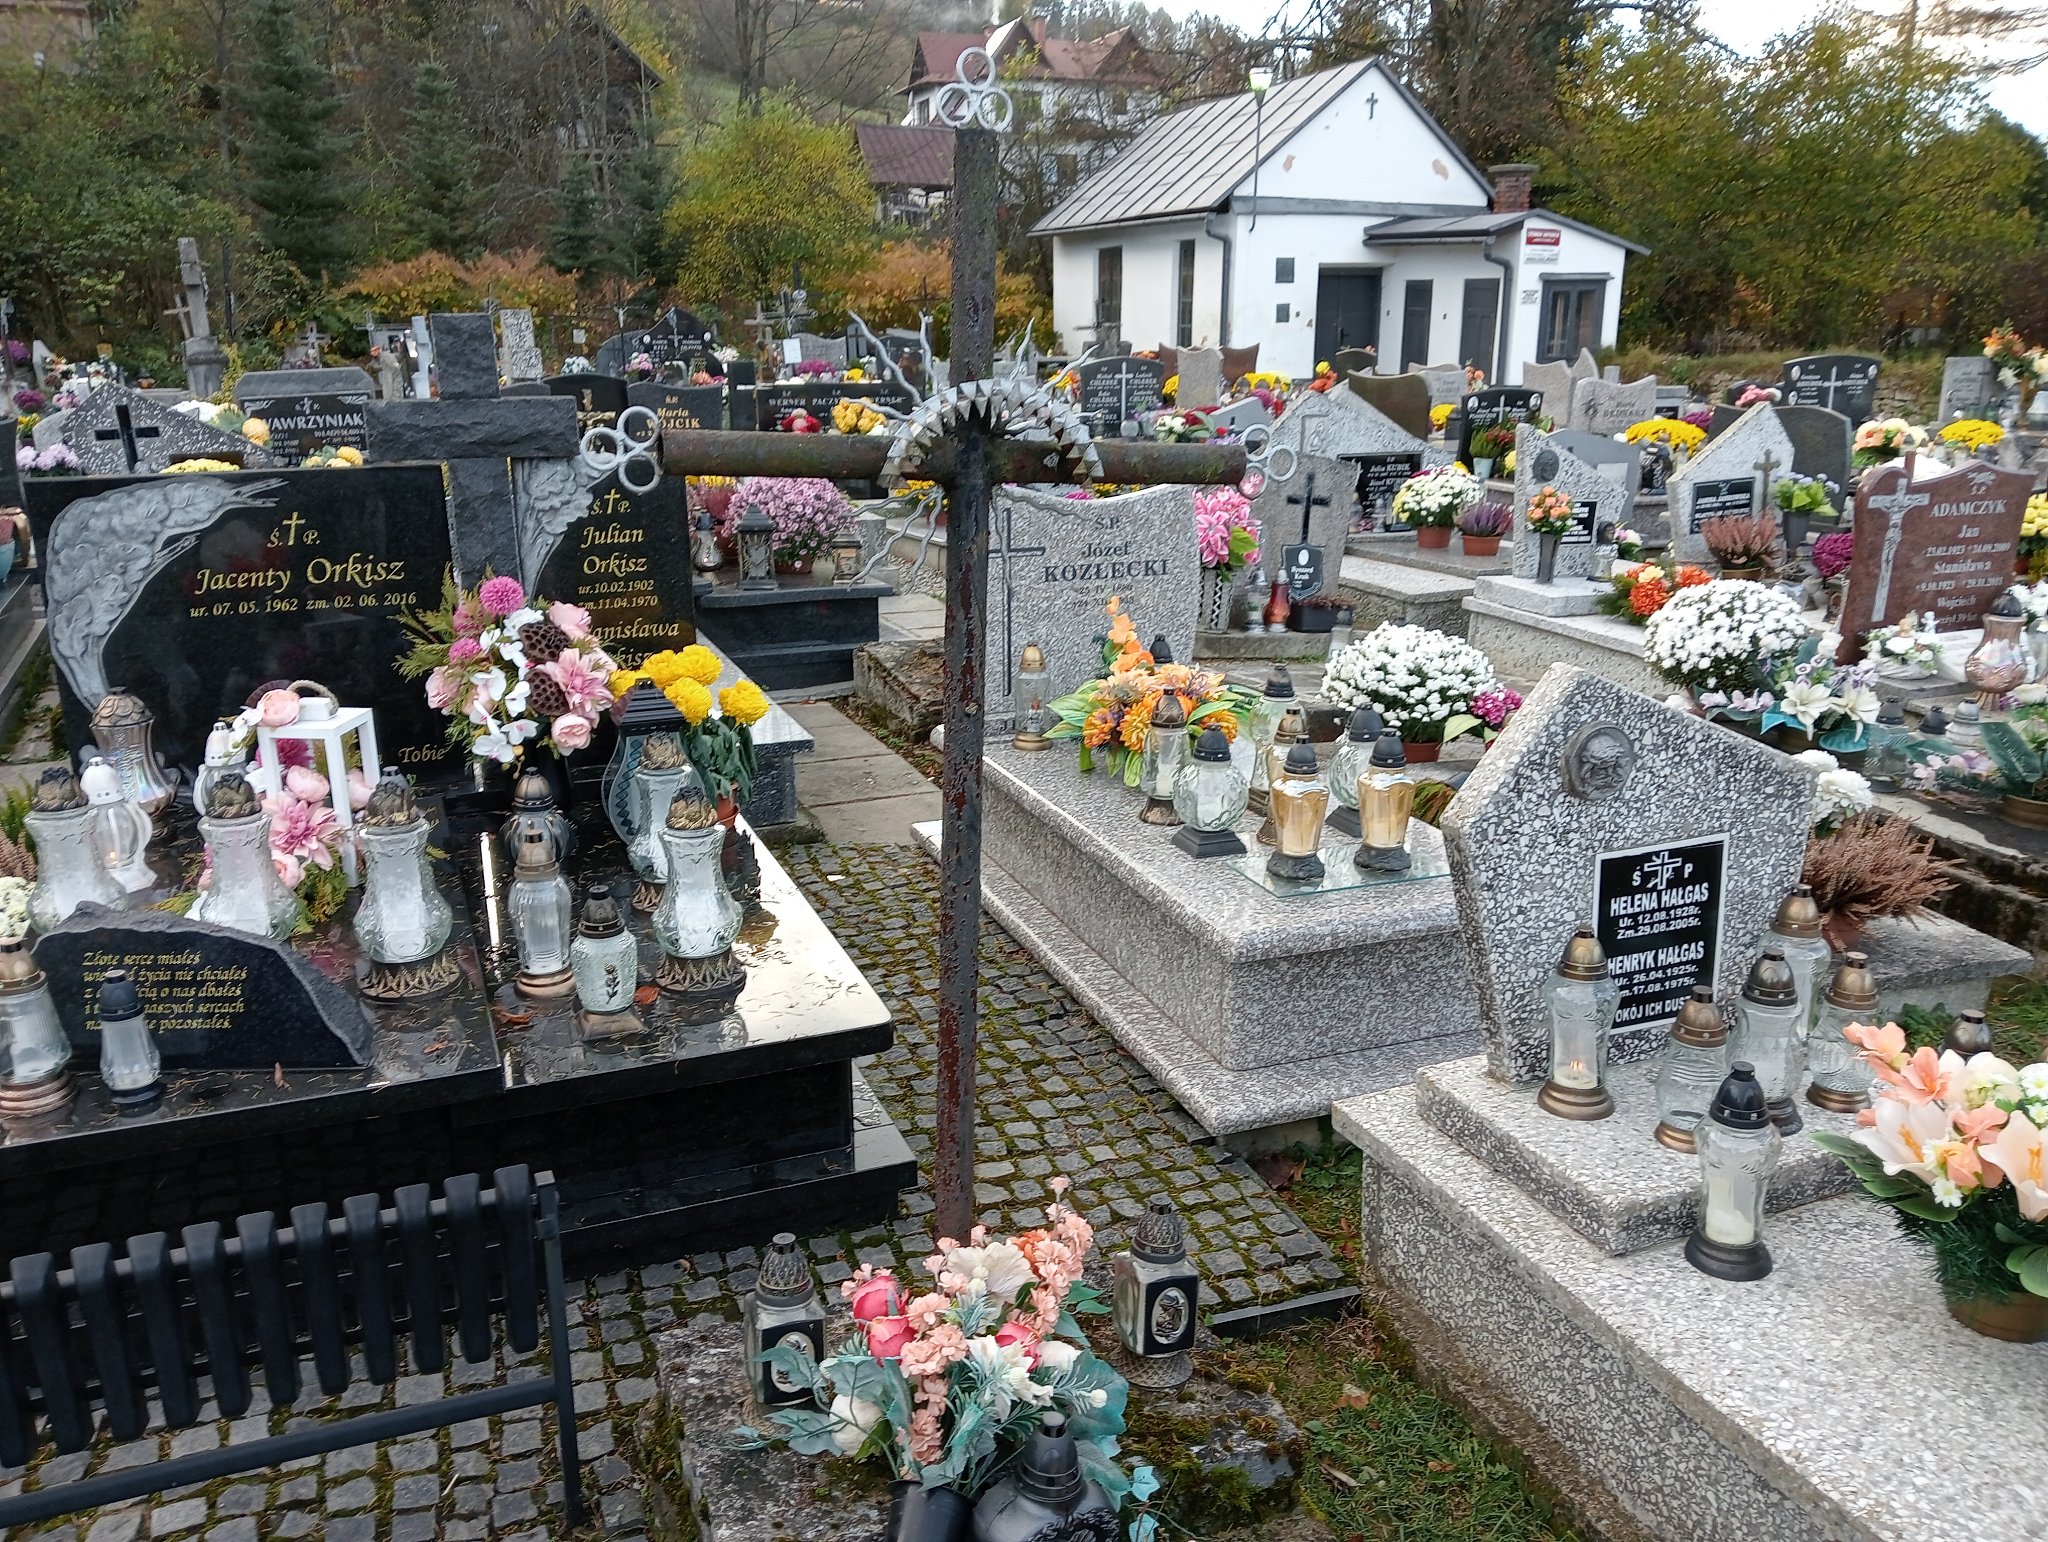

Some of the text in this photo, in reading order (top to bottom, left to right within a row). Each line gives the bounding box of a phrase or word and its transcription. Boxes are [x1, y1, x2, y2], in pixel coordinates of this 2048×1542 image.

[1930, 499, 2007, 518] ADAMCZYK
[580, 522, 645, 549] Julian
[1958, 525, 1980, 538] Jan
[1081, 540, 1132, 558] Józef
[194, 552, 405, 595] Jacenty Orkisz
[583, 552, 648, 578] Orkisz
[190, 592, 417, 618] ur. 07. 05. 1962 zm. 02. 06. 2016
[588, 618, 680, 641] anisława
[398, 744, 446, 763] Tobie
[1632, 863, 1693, 886] Ś P
[1610, 882, 1709, 917] HELENA HAŁGAS
[1619, 905, 1702, 928] Ur. 12.08.1928r.
[82, 949, 202, 966] Złote serce miałeś
[1607, 940, 1705, 976] HENRYK HAŁGAS
[138, 967, 172, 985] życia
[175, 967, 194, 981] nie
[196, 965, 248, 981] chciałeś
[1632, 964, 1699, 984] 26.04.1925r.
[160, 988, 169, 998] o
[172, 985, 196, 998] nas
[198, 982, 243, 998] dbałeś
[1619, 976, 1697, 998] m.17.08.1975r.
[195, 998, 245, 1014] sercach
[1615, 1004, 1643, 1023] OKÓJ
[1645, 1001, 1663, 1017] ICH
